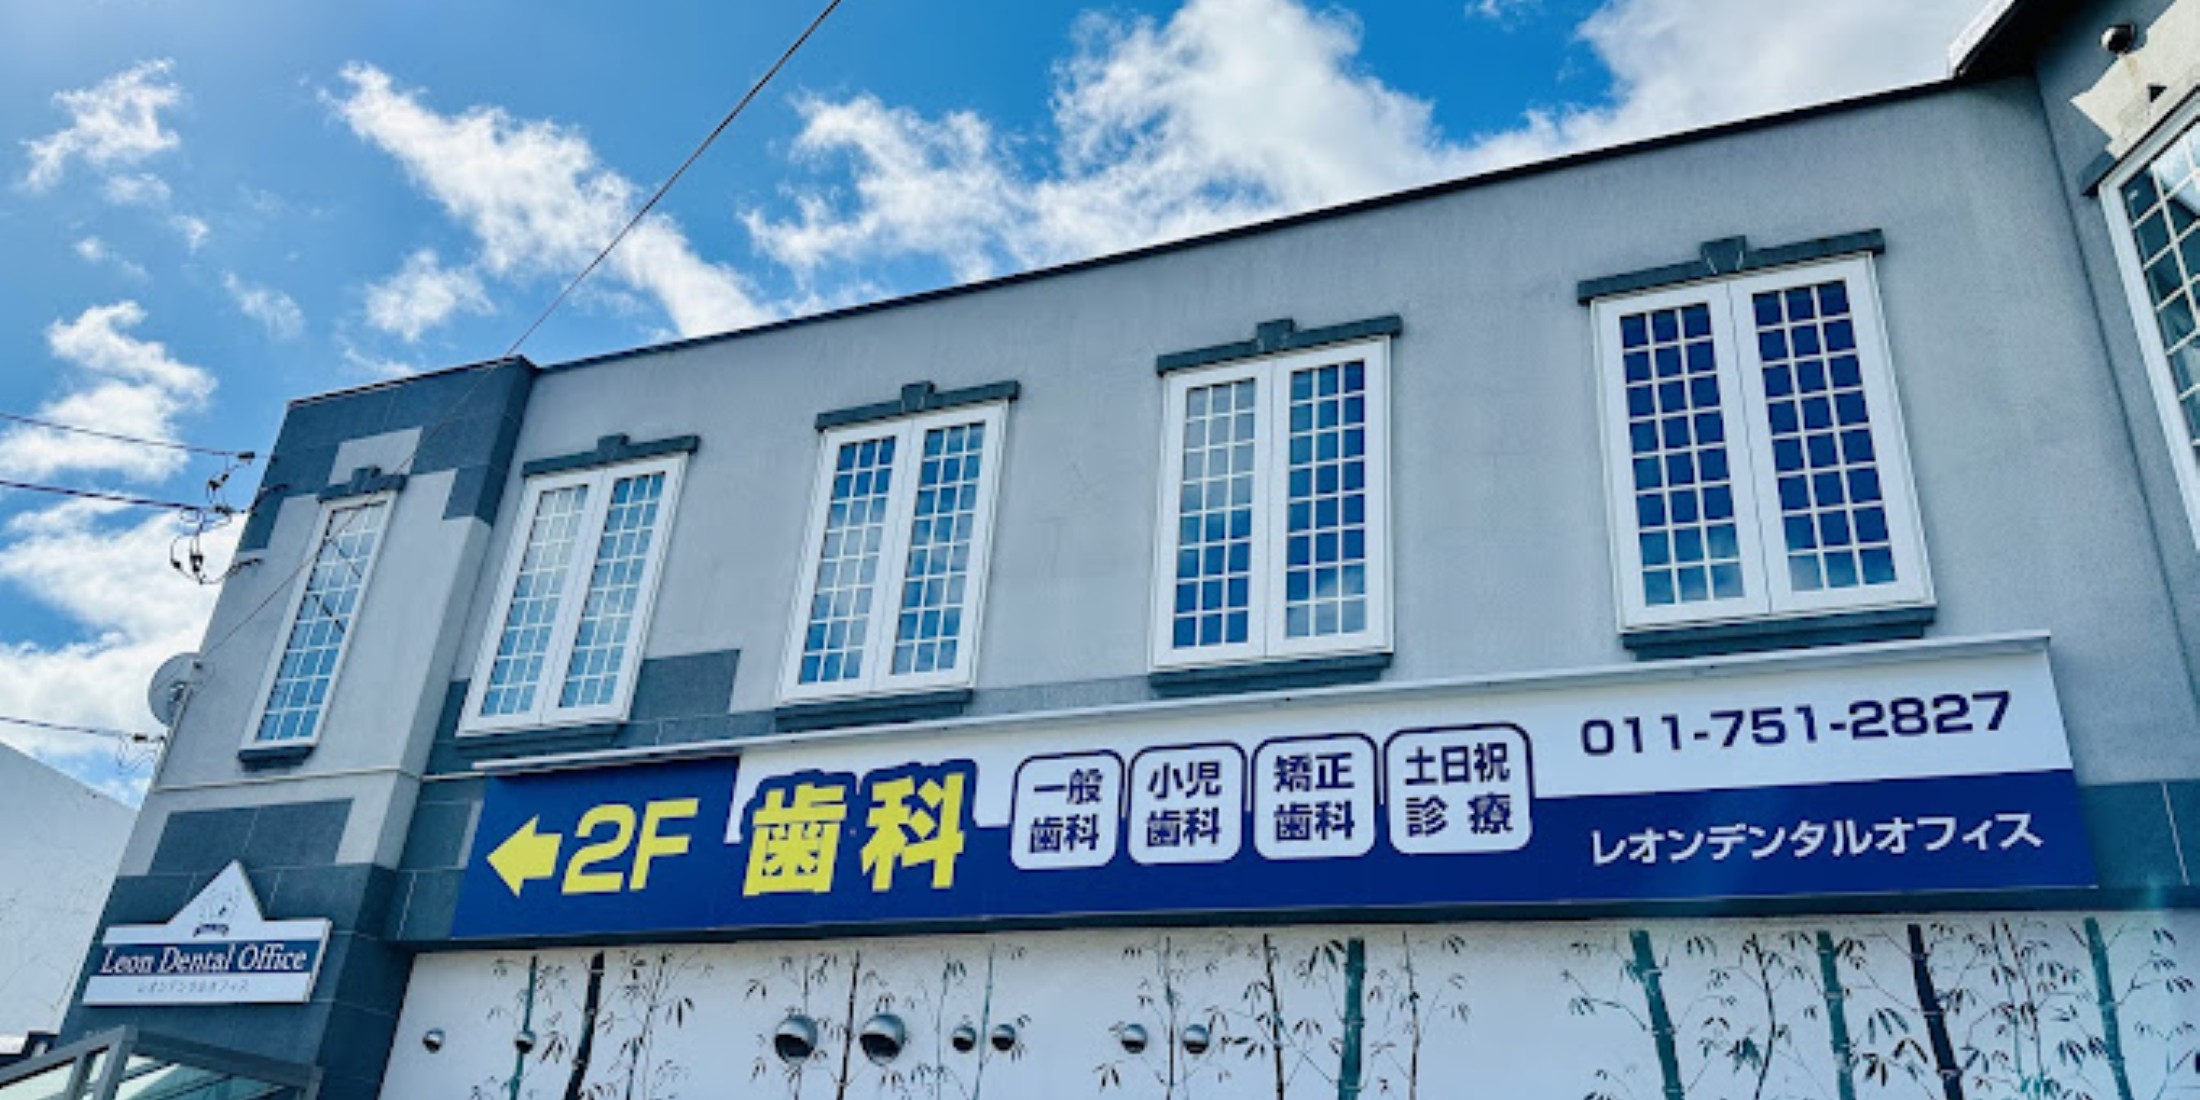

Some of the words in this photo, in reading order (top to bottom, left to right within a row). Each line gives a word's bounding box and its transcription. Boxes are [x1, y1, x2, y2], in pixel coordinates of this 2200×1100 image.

[1582, 691, 2010, 755] 011-751-2827
[1148, 761, 1221, 800] 小児
[1273, 752, 1355, 793] 矯正
[1405, 742, 1510, 785] 土日祝
[1033, 768, 1103, 805] 一般
[743, 774, 964, 895] 歯科
[1029, 813, 1100, 854] 歯科
[1146, 806, 1220, 848] 歯科
[1273, 800, 1355, 842] 歯科
[1406, 793, 1513, 837] 診療
[563, 799, 697, 893] 2F
[1592, 812, 2044, 865] レオンデンタルオフィス
[100, 947, 155, 974] Leon
[157, 944, 236, 974] Dental
[237, 943, 307, 971] Office
